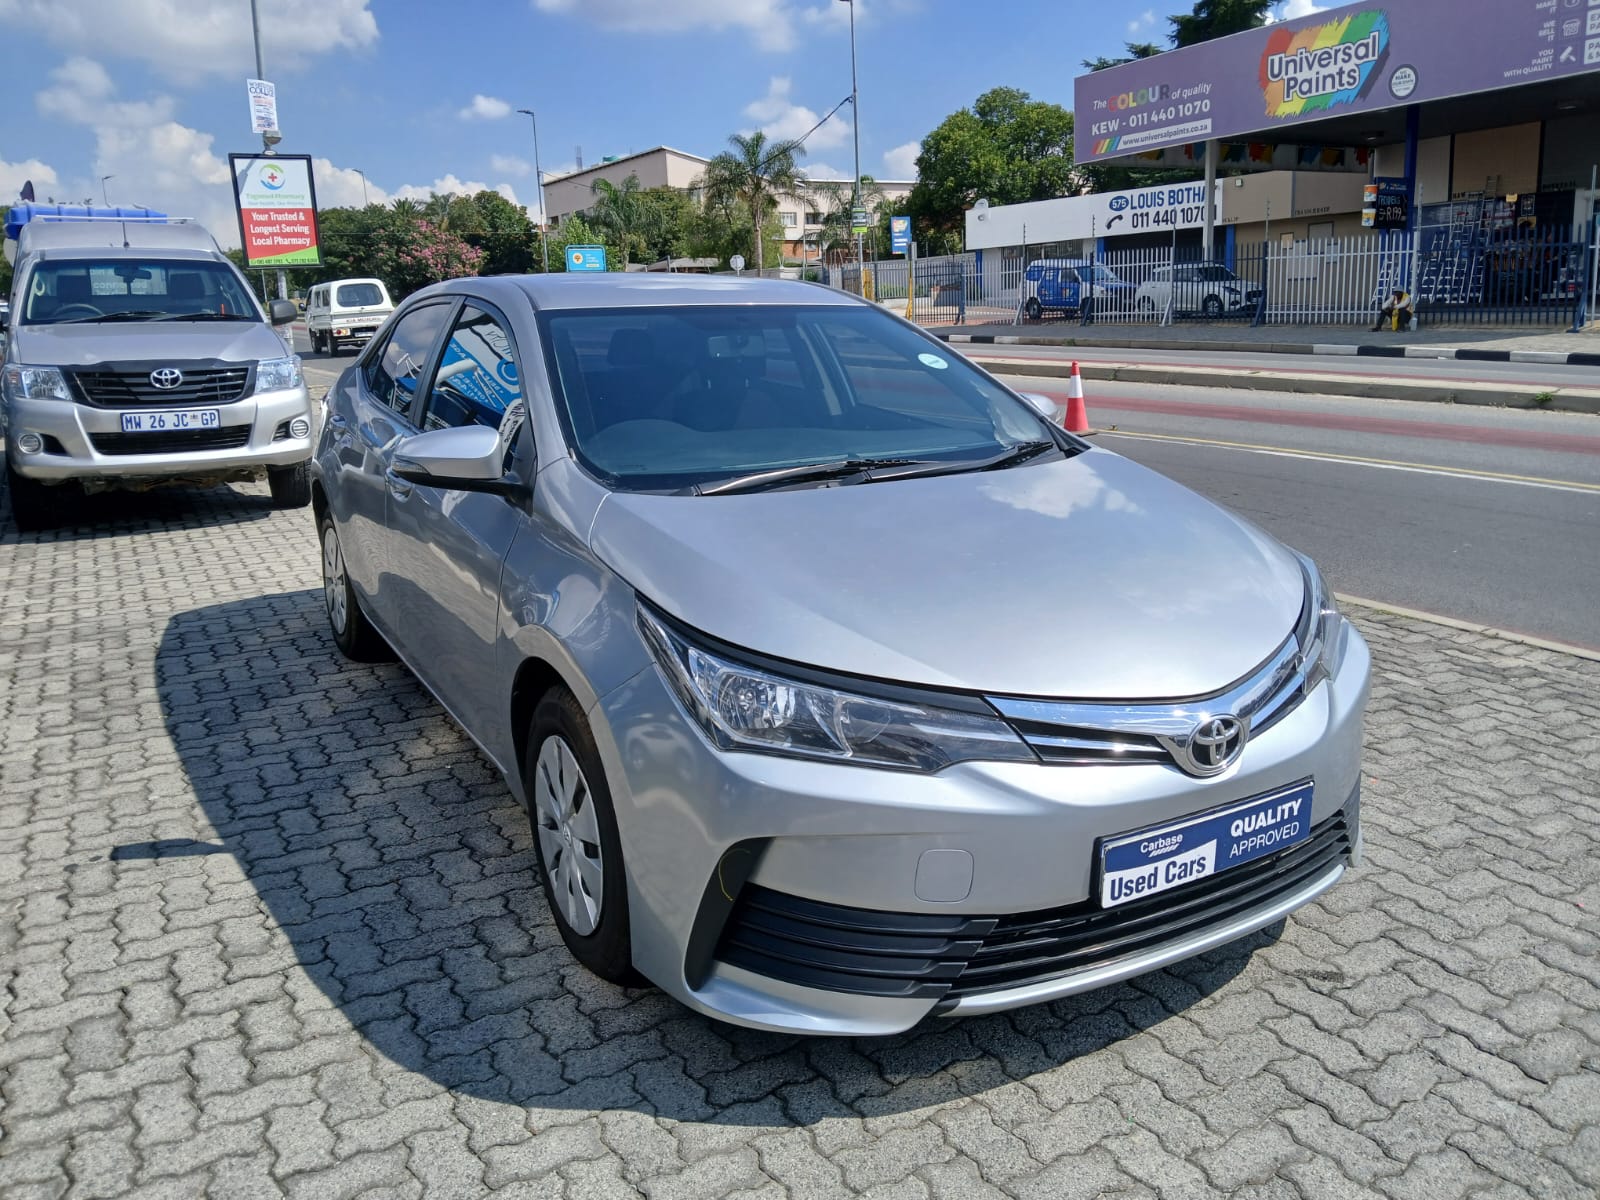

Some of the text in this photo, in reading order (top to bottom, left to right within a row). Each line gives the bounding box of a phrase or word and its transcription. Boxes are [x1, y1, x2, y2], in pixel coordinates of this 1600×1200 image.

[1268, 32, 1379, 81] Universal
[1531, 56, 1553, 65] PAINT
[1538, 49, 1554, 57] YOU
[1504, 63, 1553, 77] WITH QUALITY
[1285, 65, 1358, 100] Paints
[1093, 83, 1212, 112] The COLOUR of quality
[1091, 118, 1120, 136] KEW
[1129, 112, 1148, 127] 011
[1150, 107, 1176, 122] 440
[1178, 99, 1211, 118] 1070
[1122, 123, 1208, 146] www.universalpaints.co.za
[1112, 199, 1127, 209] 575
[1130, 191, 1165, 210] LOUIS
[251, 211, 305, 221] Your Trusted &
[1132, 212, 1149, 228] 011
[1153, 208, 1177, 226] 440
[250, 223, 310, 235] Longest Serving
[252, 236, 310, 247] Local Pharmacy
[125, 412, 217, 430] MW 26 JC GP
[1230, 798, 1302, 838] QUALITY
[1140, 833, 1183, 854] Carbase
[1229, 821, 1300, 859] APPROVED
[1110, 855, 1206, 901] Used Cars
